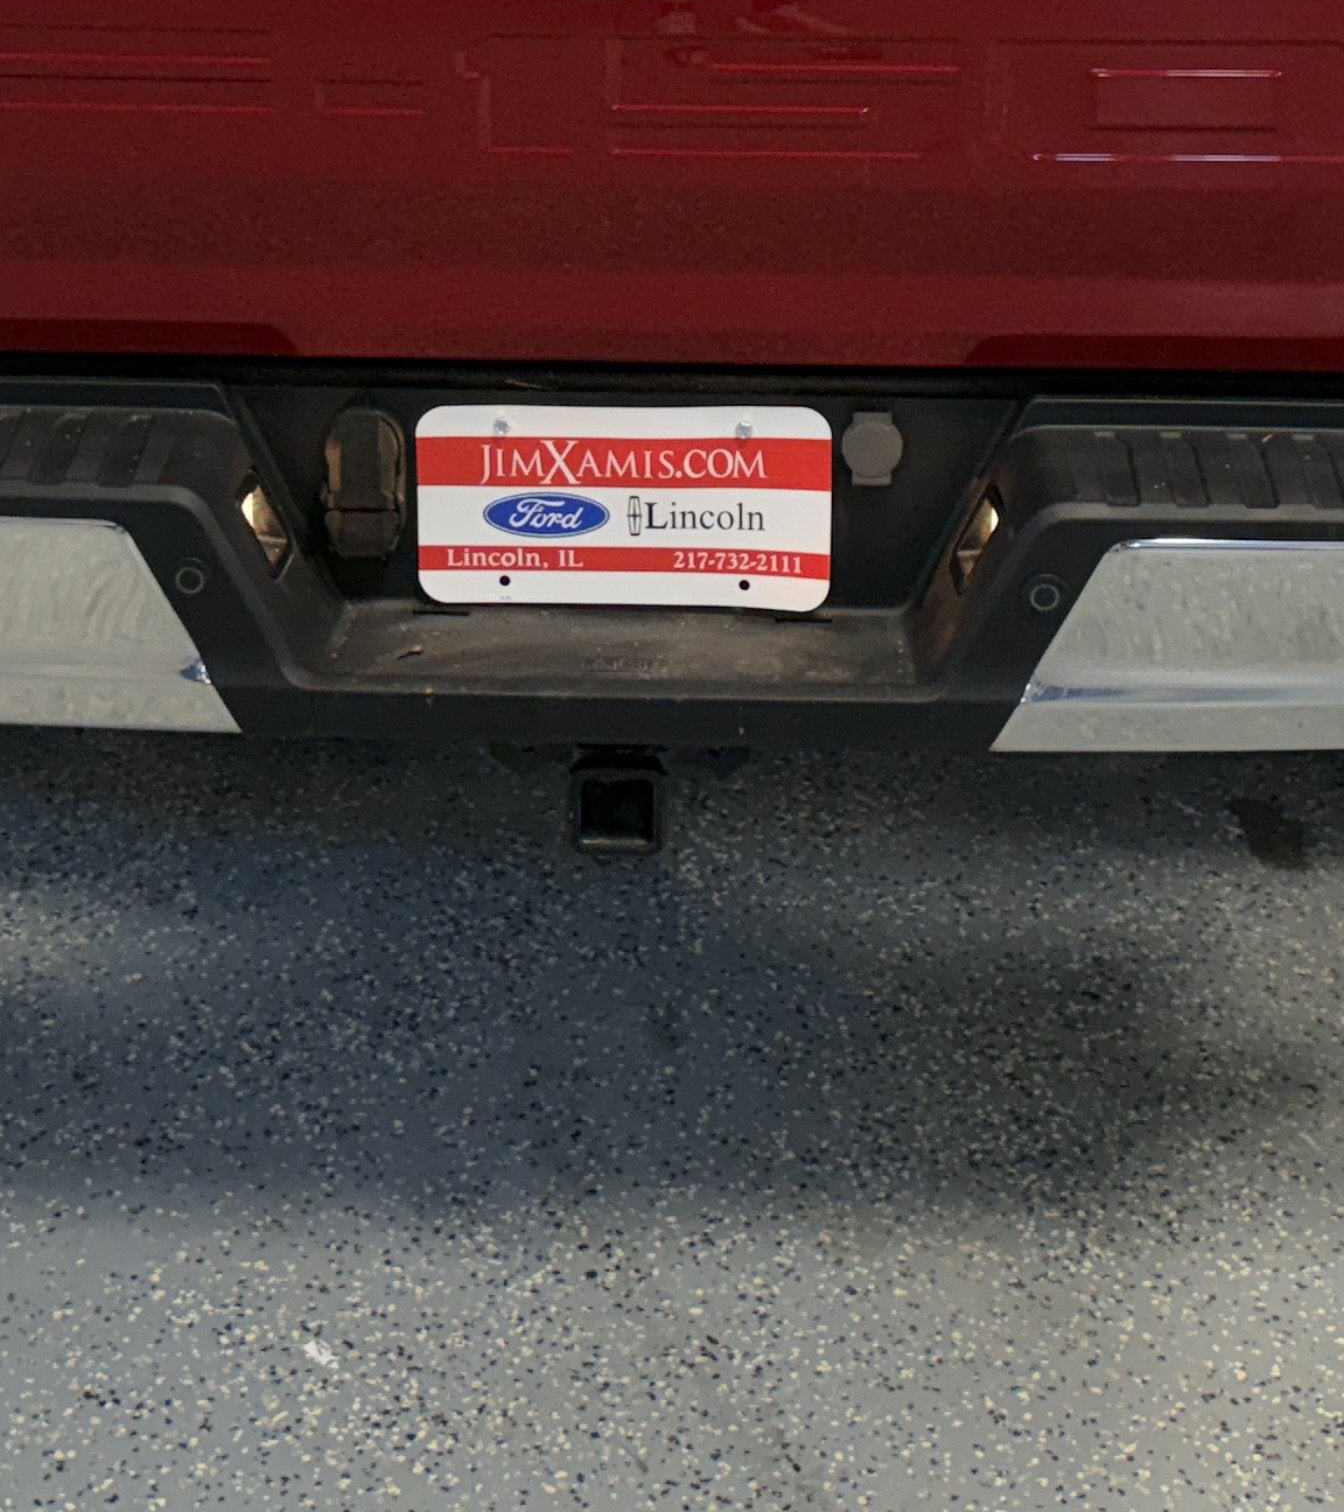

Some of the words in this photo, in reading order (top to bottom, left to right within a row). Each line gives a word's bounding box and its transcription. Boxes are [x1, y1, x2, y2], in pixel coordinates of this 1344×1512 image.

[479, 439, 767, 485] JIMXAMIS.COM
[508, 498, 584, 530] Ford
[644, 501, 766, 532] Lincoln
[447, 548, 549, 569] Lincoln,
[558, 550, 584, 569] IL
[673, 550, 802, 574] 217-732-2111
